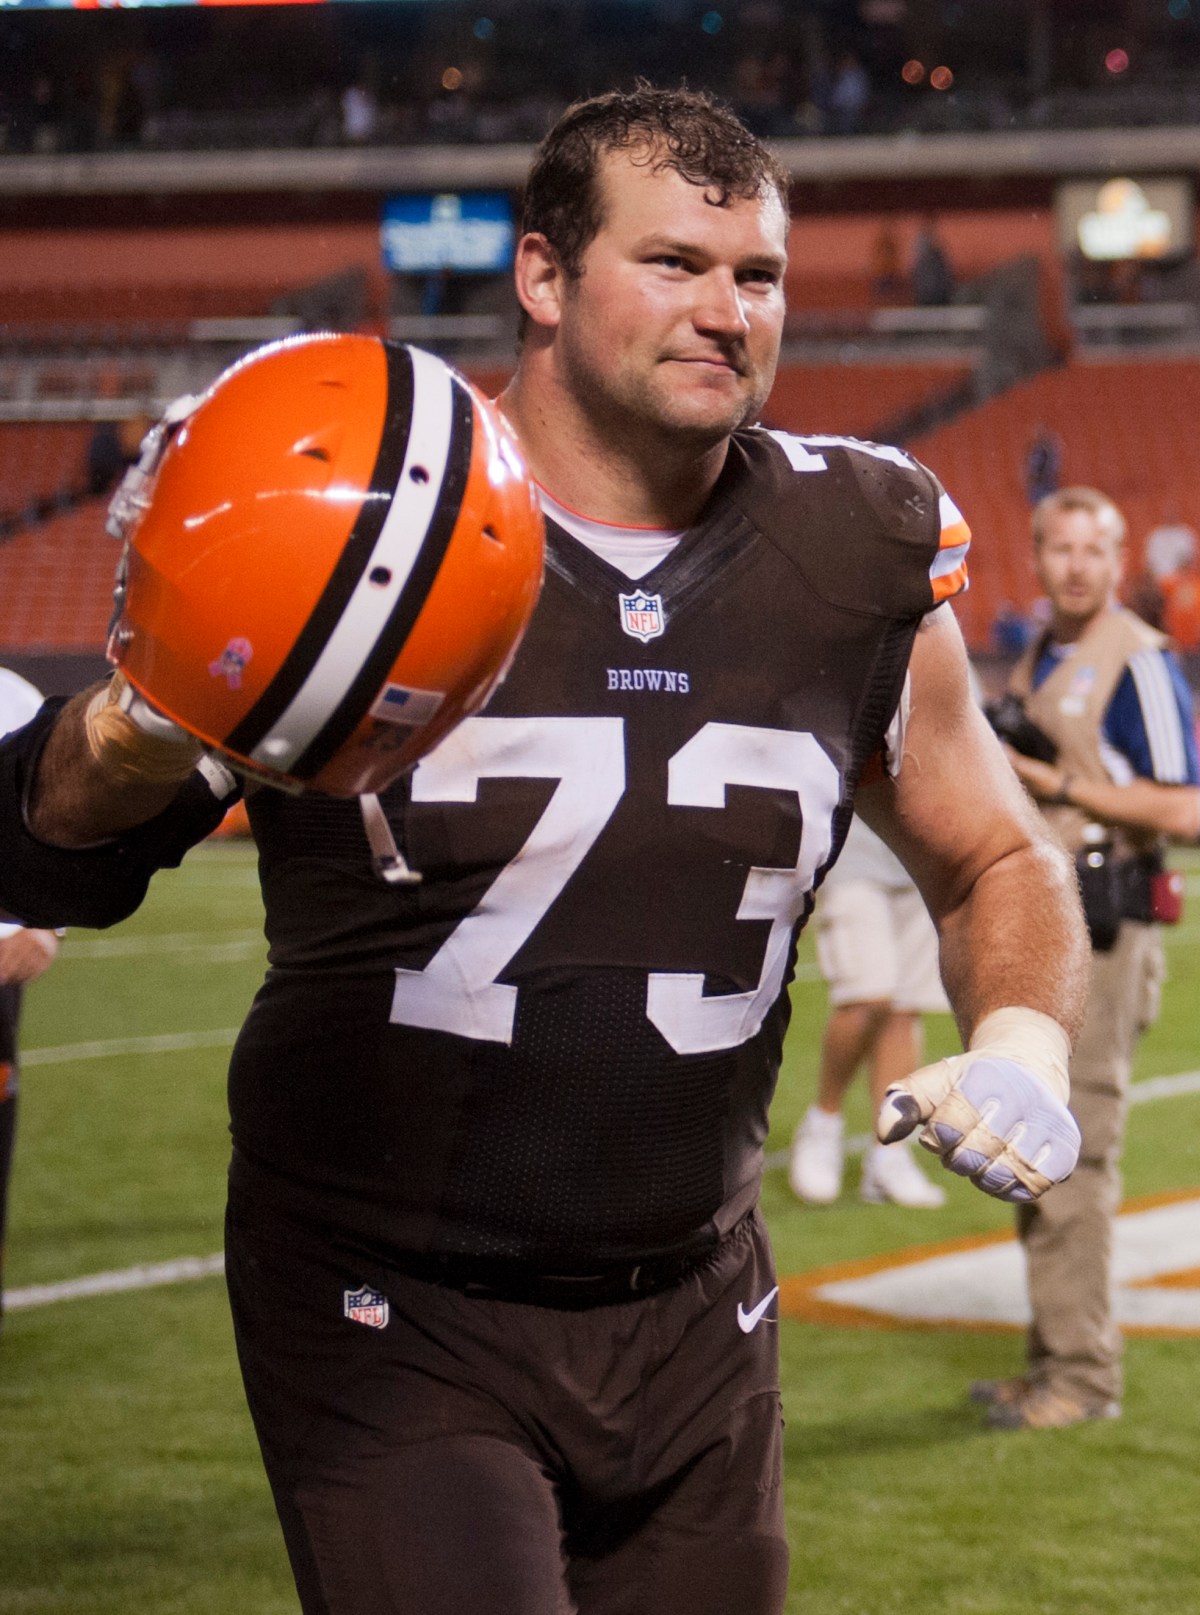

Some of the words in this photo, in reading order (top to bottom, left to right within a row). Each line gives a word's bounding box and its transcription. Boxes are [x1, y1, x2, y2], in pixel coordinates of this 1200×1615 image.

[628, 612, 658, 632] NFL
[607, 668, 690, 693] BROWNS
[389, 716, 840, 1055] 73
[351, 1307, 382, 1326] NFL
